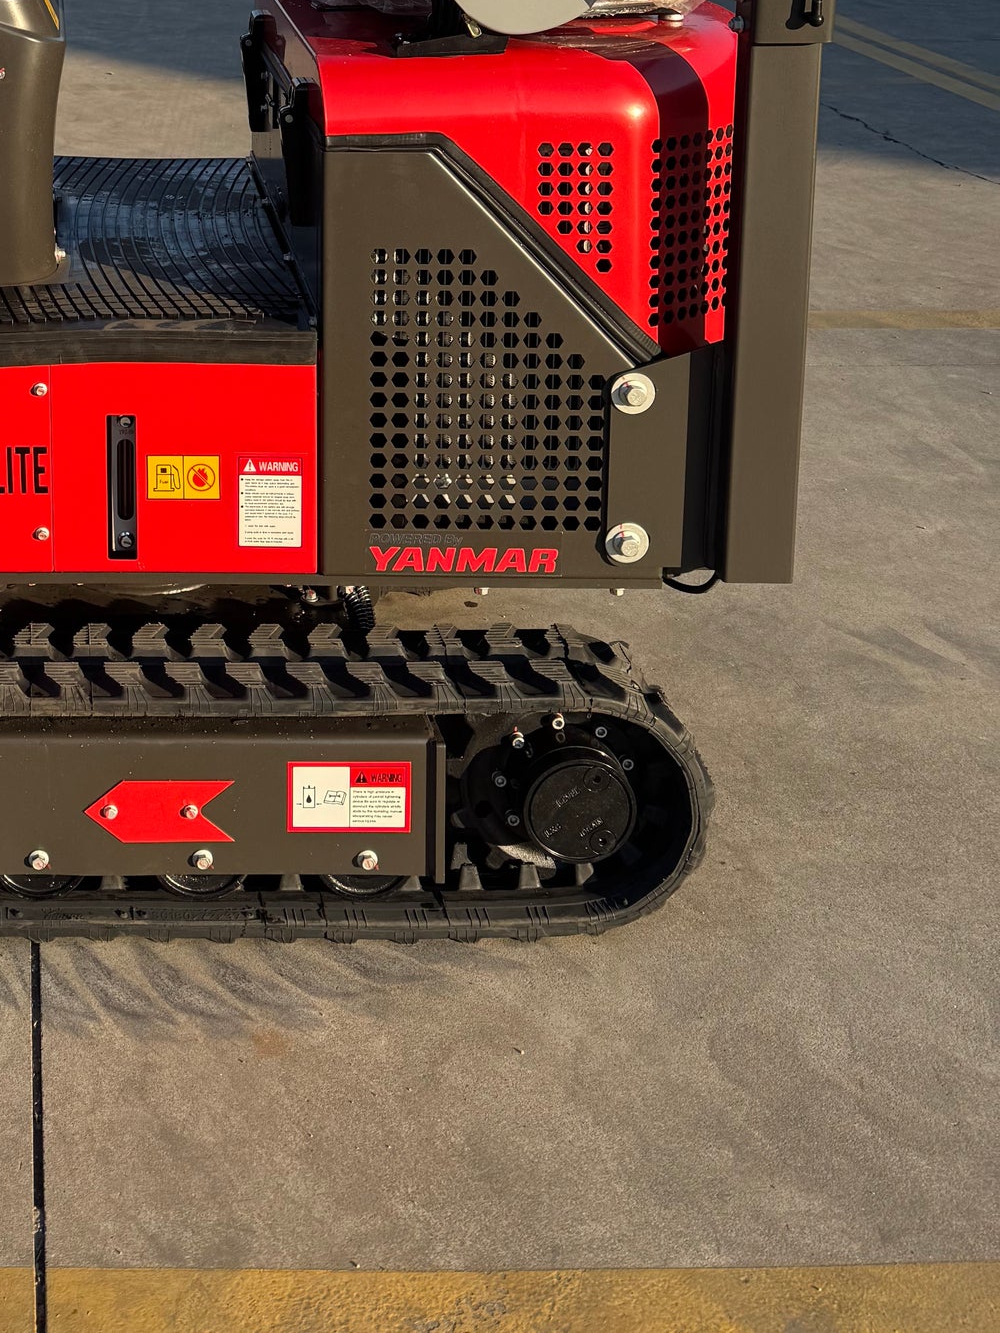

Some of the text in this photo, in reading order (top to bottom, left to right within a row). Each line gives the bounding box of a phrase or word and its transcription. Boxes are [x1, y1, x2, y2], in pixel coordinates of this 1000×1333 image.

[258, 461, 299, 472] WARNING
[369, 533, 442, 545] POWERED
[369, 546, 559, 573] YANMAR
[370, 773, 403, 783] WARNING
